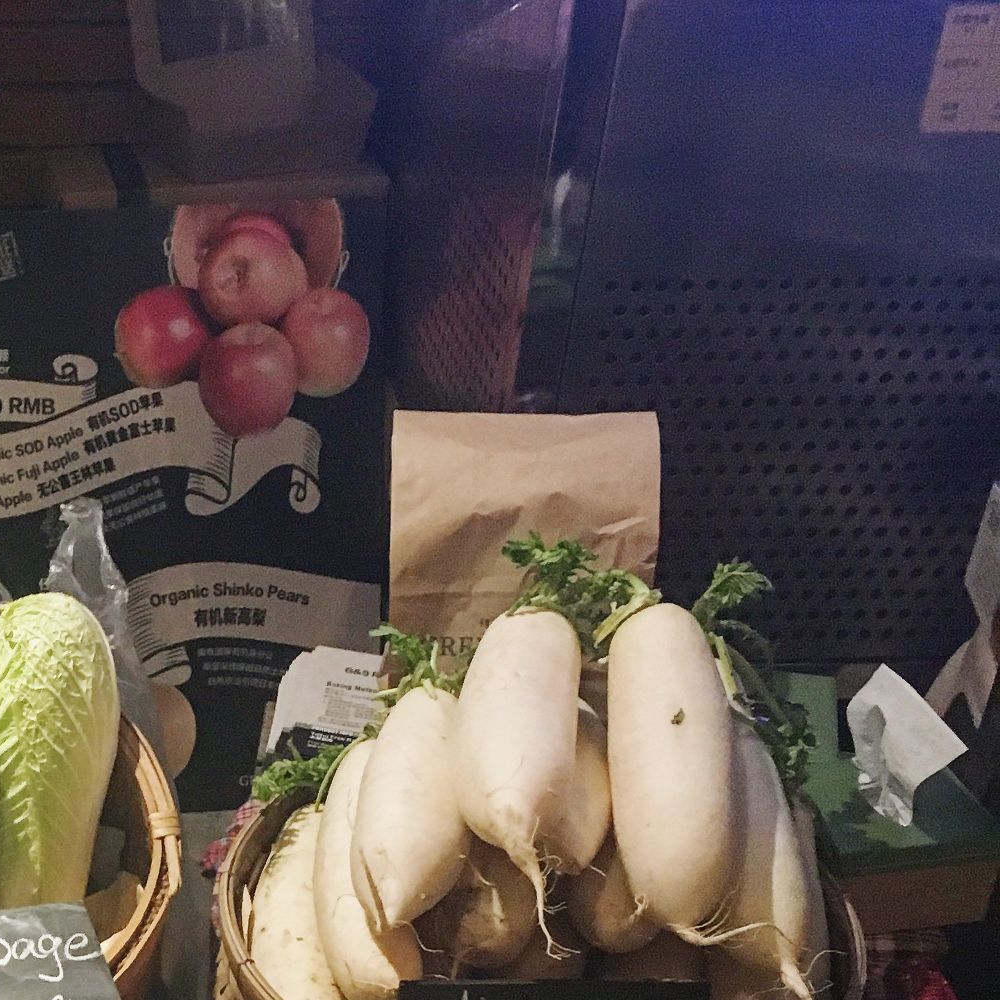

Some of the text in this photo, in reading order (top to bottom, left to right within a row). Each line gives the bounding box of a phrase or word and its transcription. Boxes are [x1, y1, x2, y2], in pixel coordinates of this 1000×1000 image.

[8, 397, 55, 415] RMB
[15, 440, 44, 457] SOD
[47, 427, 84, 448] Apple
[16, 464, 41, 481] Fuji
[43, 451, 80, 473] Apple
[150, 582, 311, 607] Organic Shinko Pears
